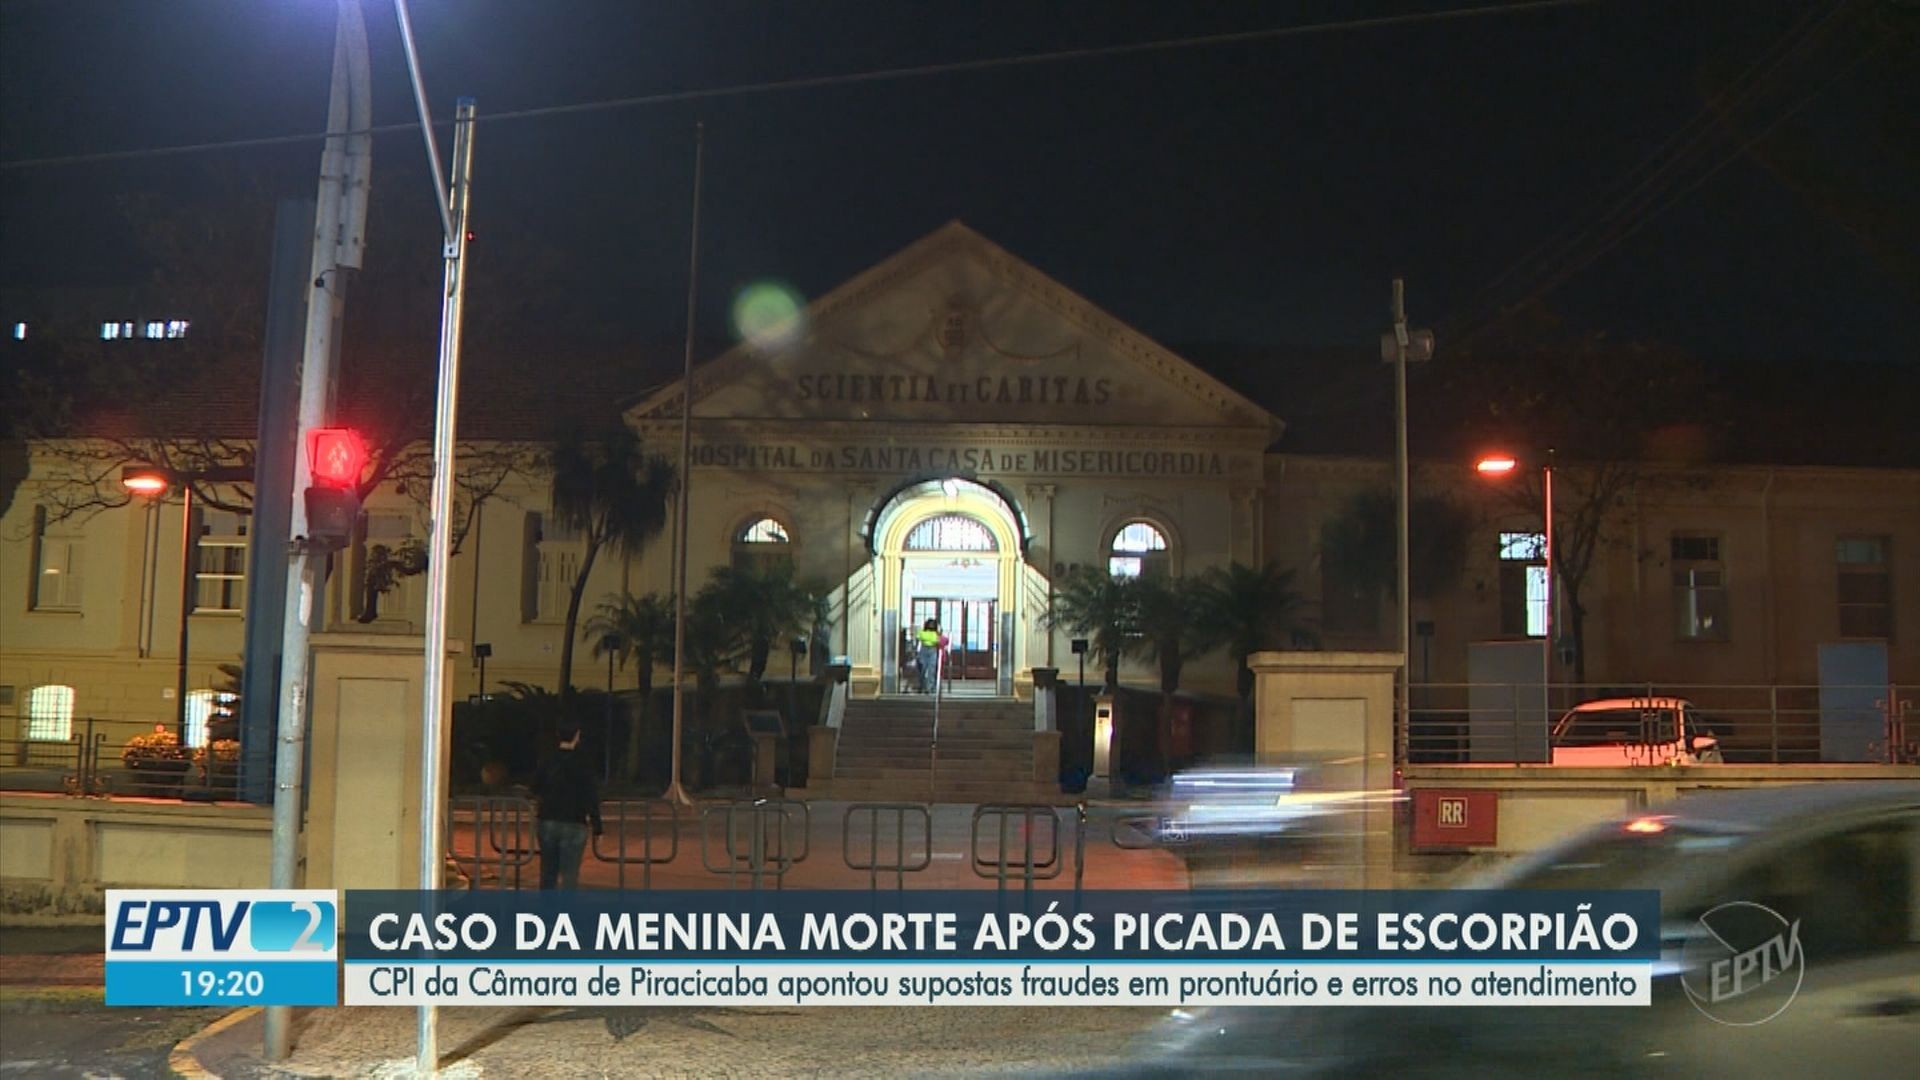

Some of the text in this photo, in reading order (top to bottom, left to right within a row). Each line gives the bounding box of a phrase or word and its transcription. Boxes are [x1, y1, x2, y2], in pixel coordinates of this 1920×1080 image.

[798, 374, 941, 402] SCIENTIA
[976, 376, 1111, 404] CARITAS
[810, 452, 835, 469] DA
[840, 446, 922, 470] SANTA
[928, 447, 995, 472] CASA
[1001, 453, 1027, 472] DE
[1033, 449, 1223, 475] MISERICORDIA
[1442, 801, 1463, 824] RR
